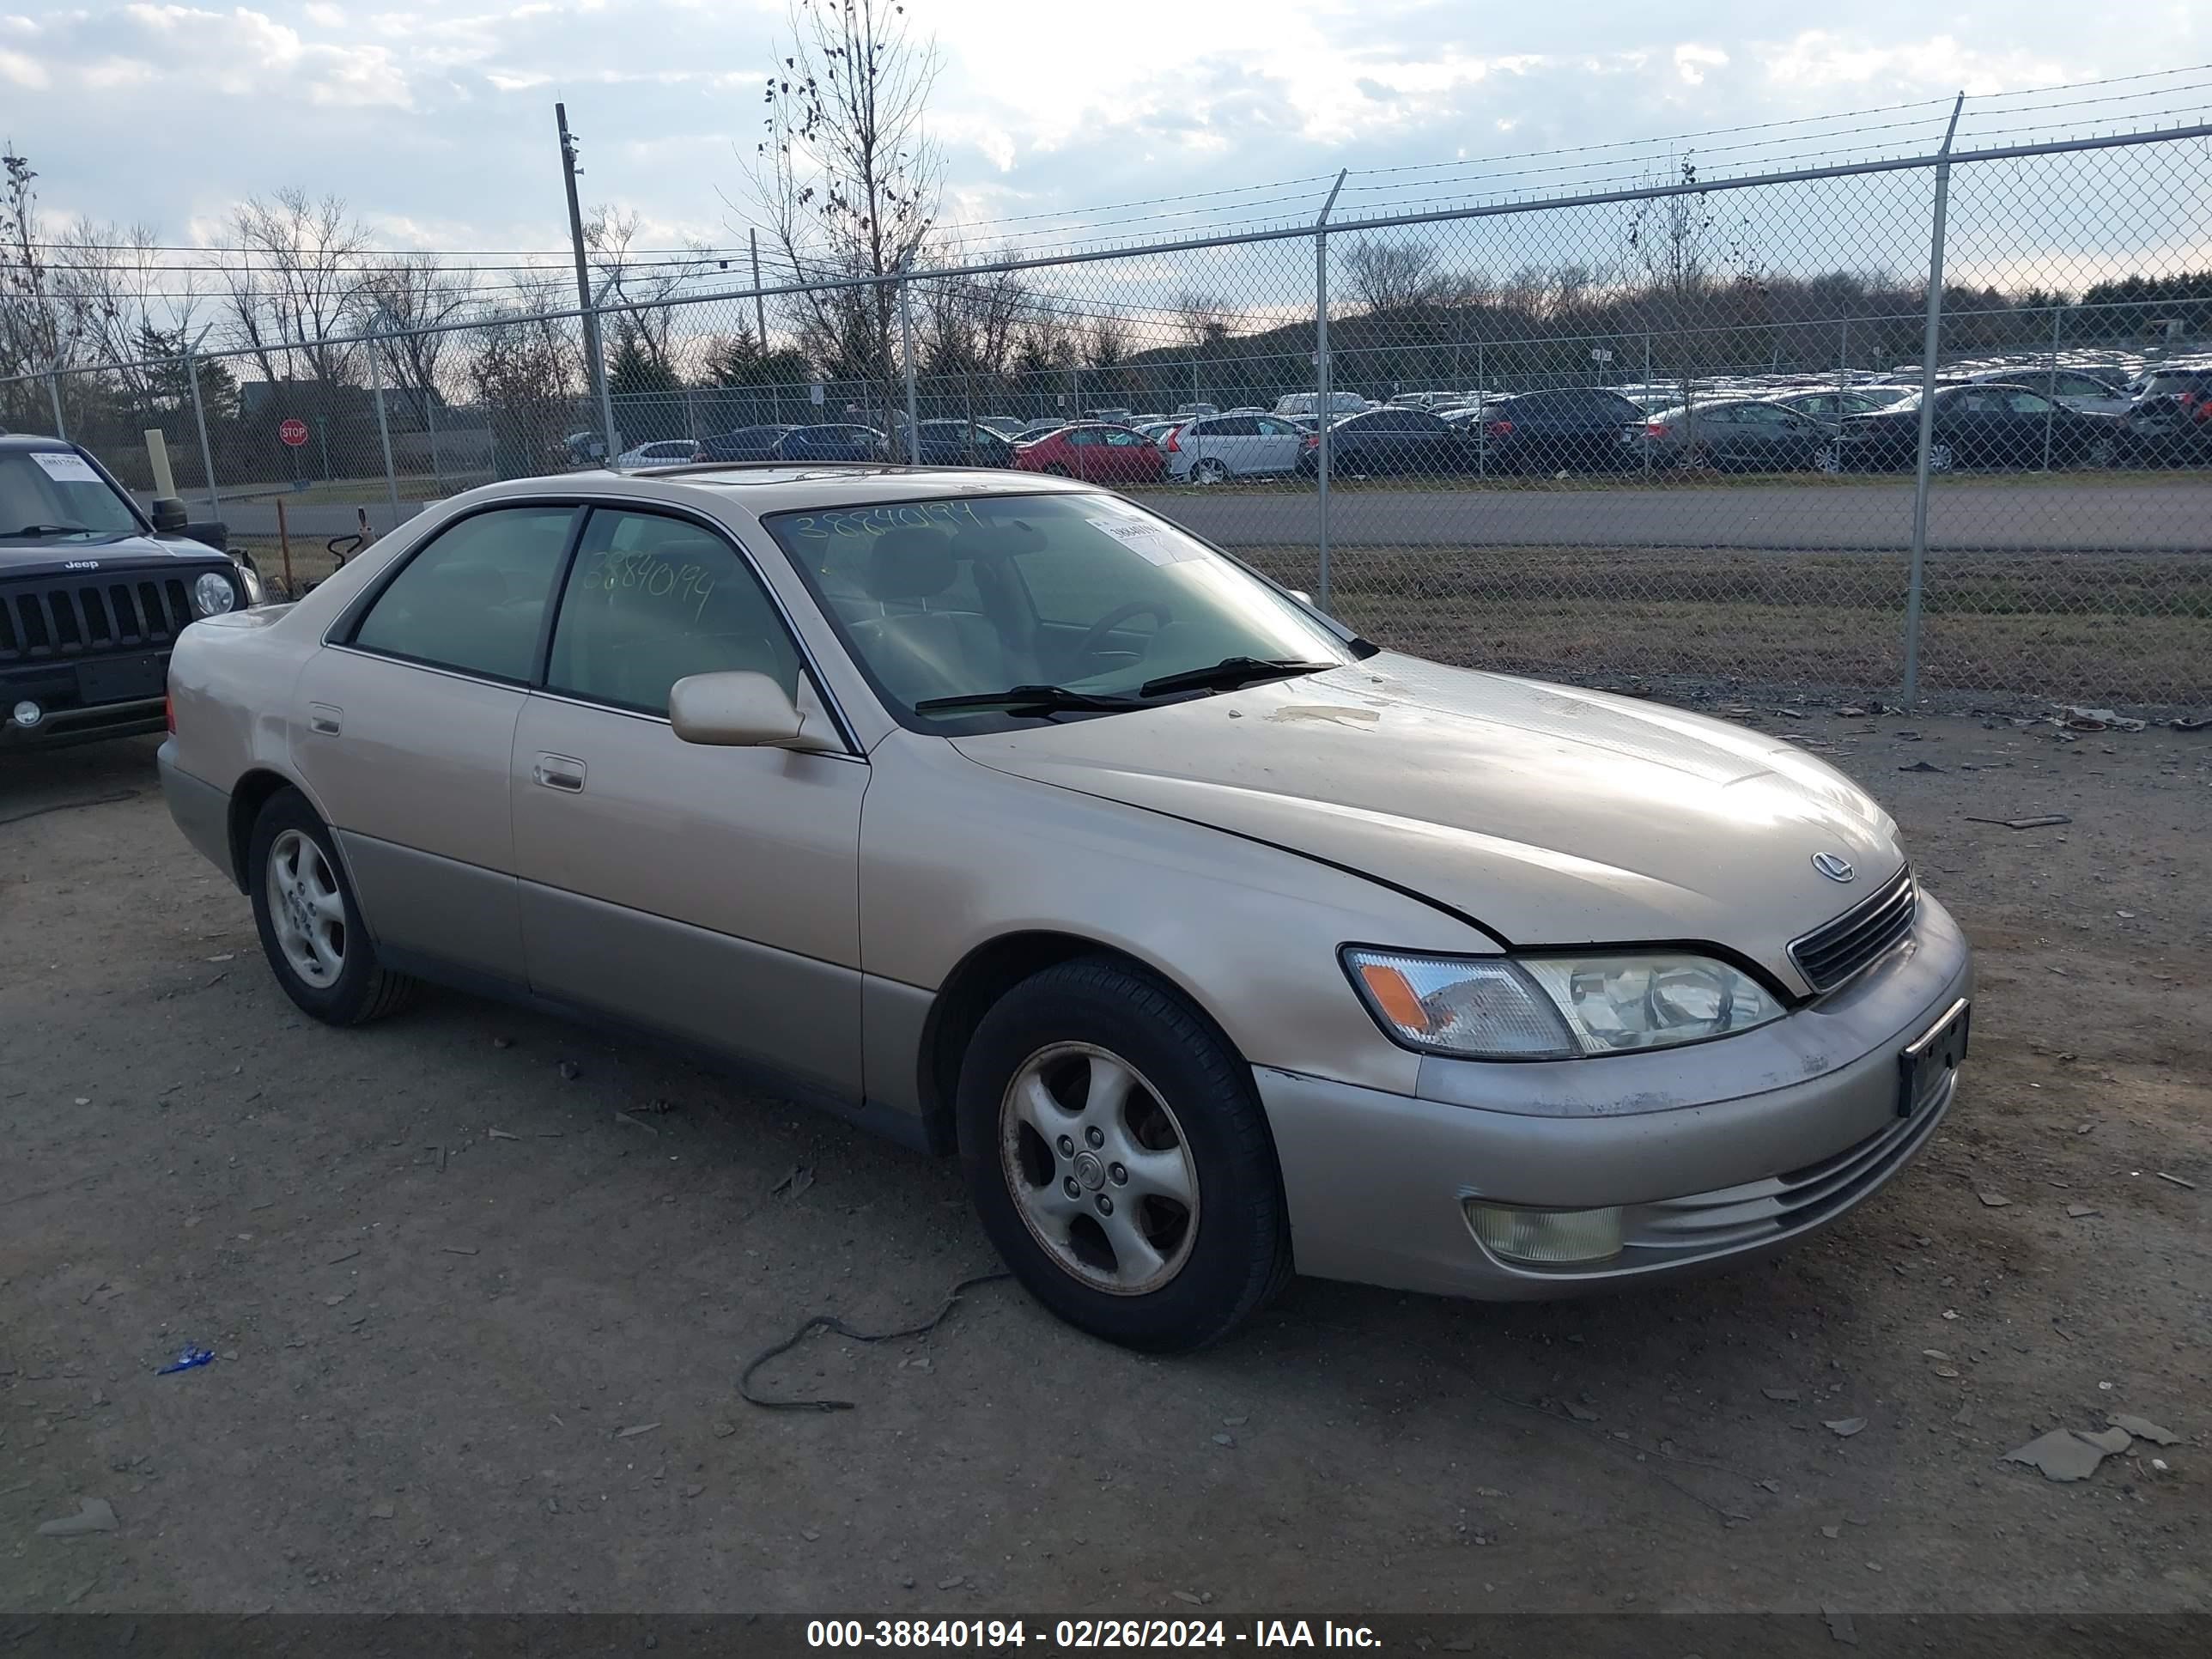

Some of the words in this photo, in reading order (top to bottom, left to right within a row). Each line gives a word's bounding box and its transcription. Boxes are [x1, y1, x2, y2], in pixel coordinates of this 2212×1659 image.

[282, 427, 305, 437] STOP
[796, 501, 984, 538] 38840194
[64, 561, 100, 569] Jeep
